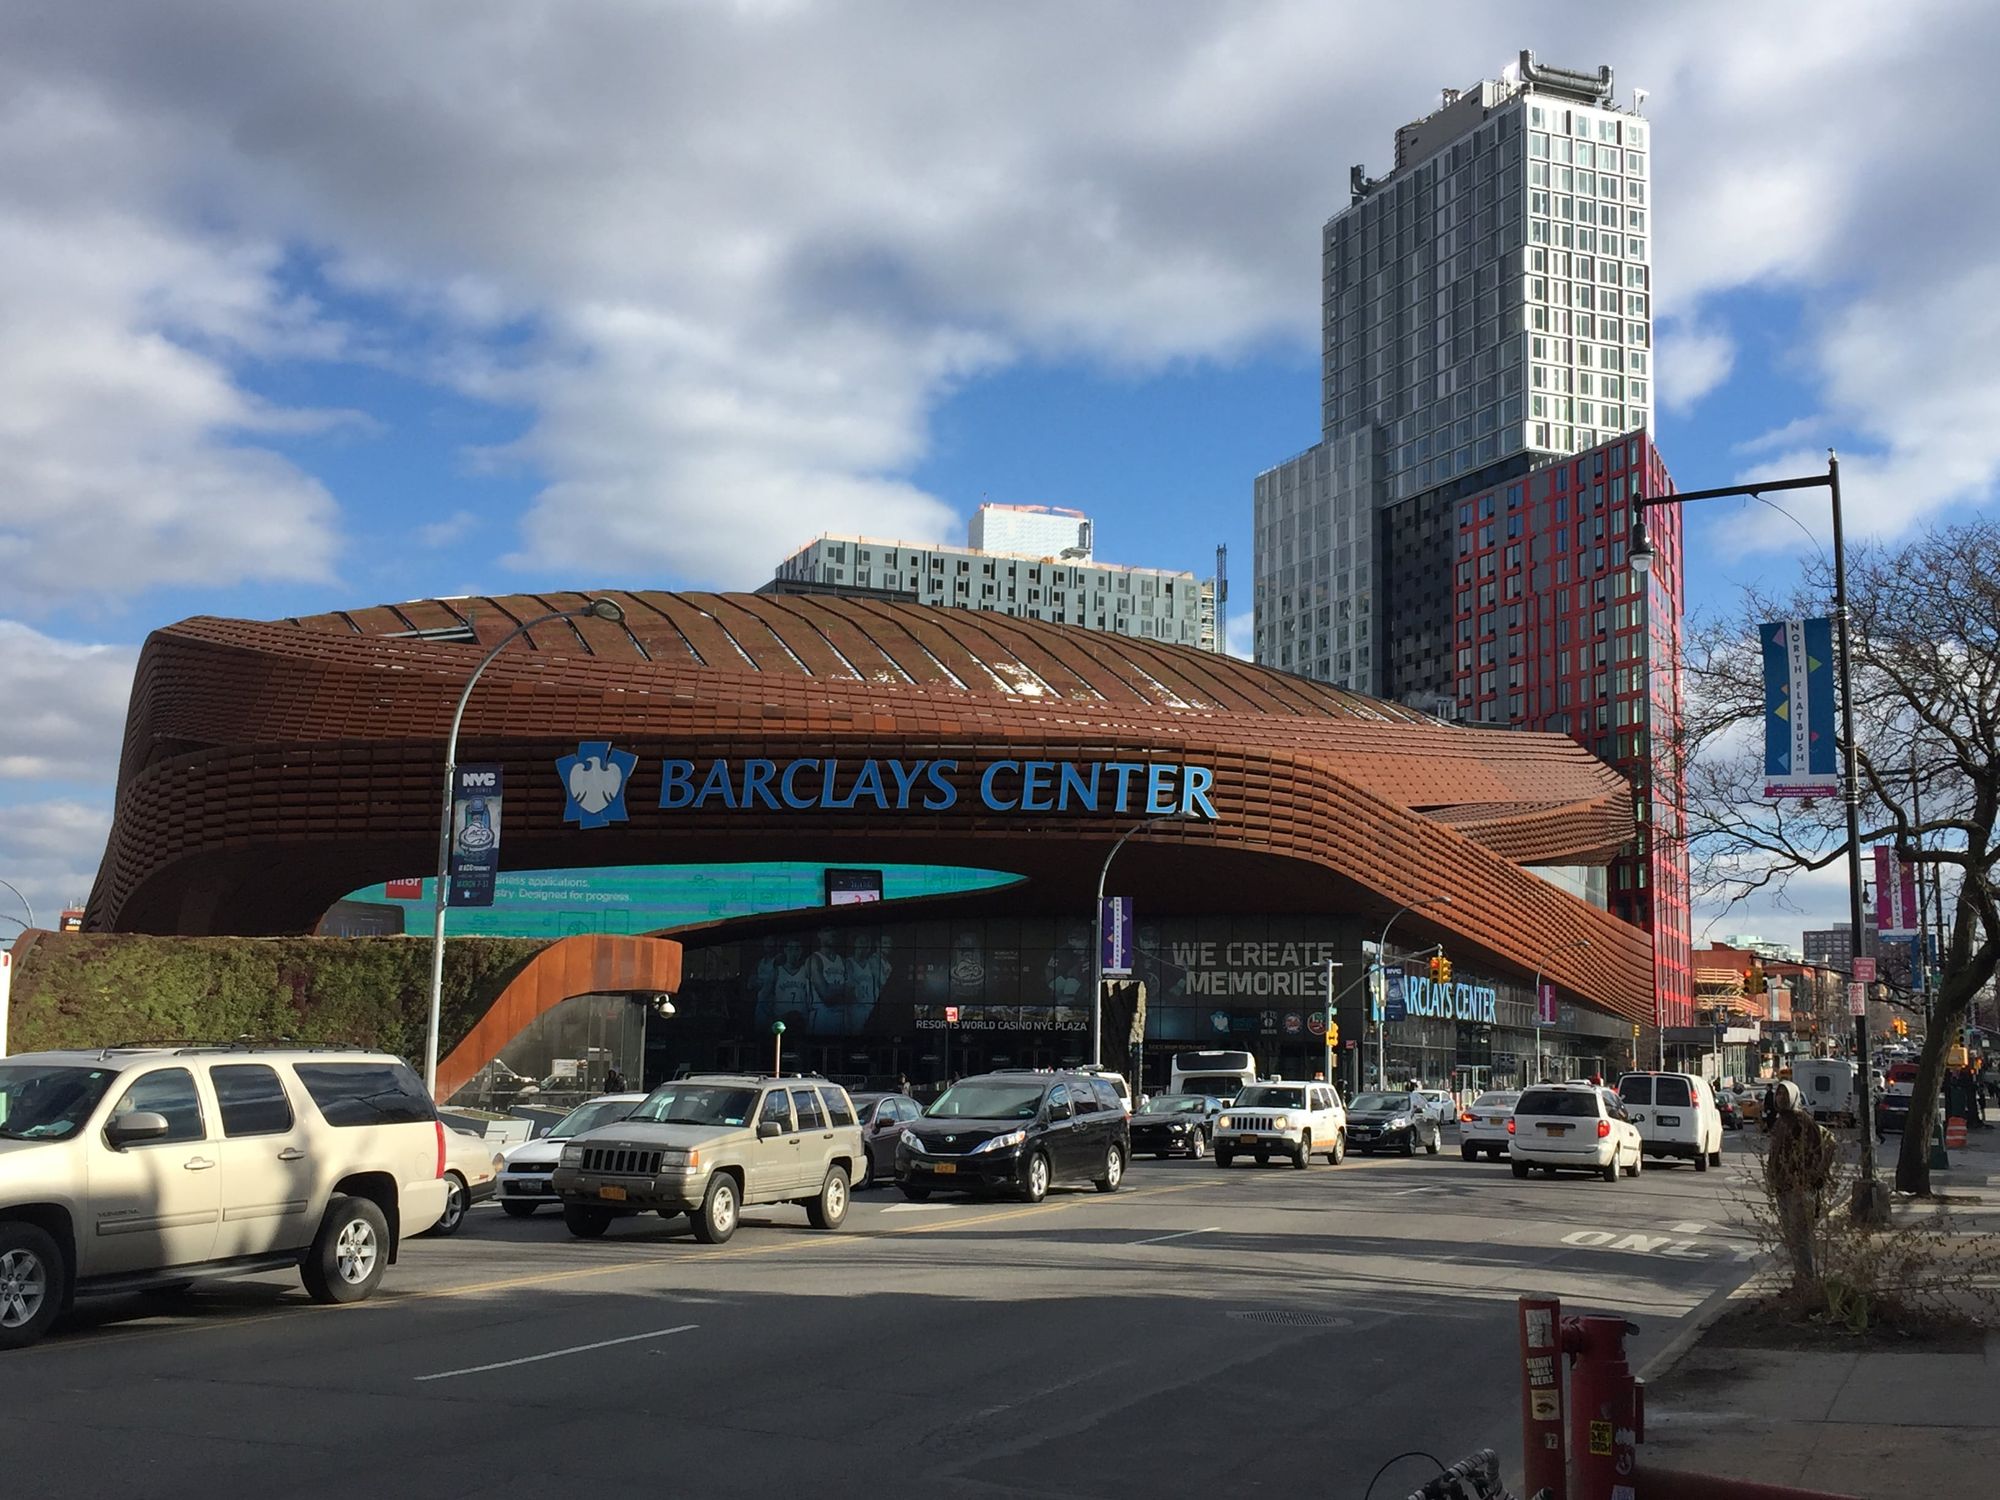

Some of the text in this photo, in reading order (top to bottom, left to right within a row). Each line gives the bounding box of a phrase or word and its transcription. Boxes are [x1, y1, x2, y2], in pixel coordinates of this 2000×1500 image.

[1790, 623, 1803, 674] NORTH
[1795, 681, 1804, 762] FLATBUSH
[463, 773, 495, 787] NYC
[658, 758, 1220, 819] BARCLAYS CENTER
[494, 876, 591, 888] siness applications.
[519, 889, 568, 901] Designed
[569, 890, 585, 900] for
[586, 892, 632, 903] progress.
[1172, 941, 1334, 967] WE CREATE
[1186, 971, 1334, 996] MEMORIES
[1403, 975, 1497, 1025] ARCLAYS CENTER
[916, 1019, 1087, 1032] RESORTS WORLD CASINO NYC PLAZA
[1530, 1375, 1555, 1386] HERE
